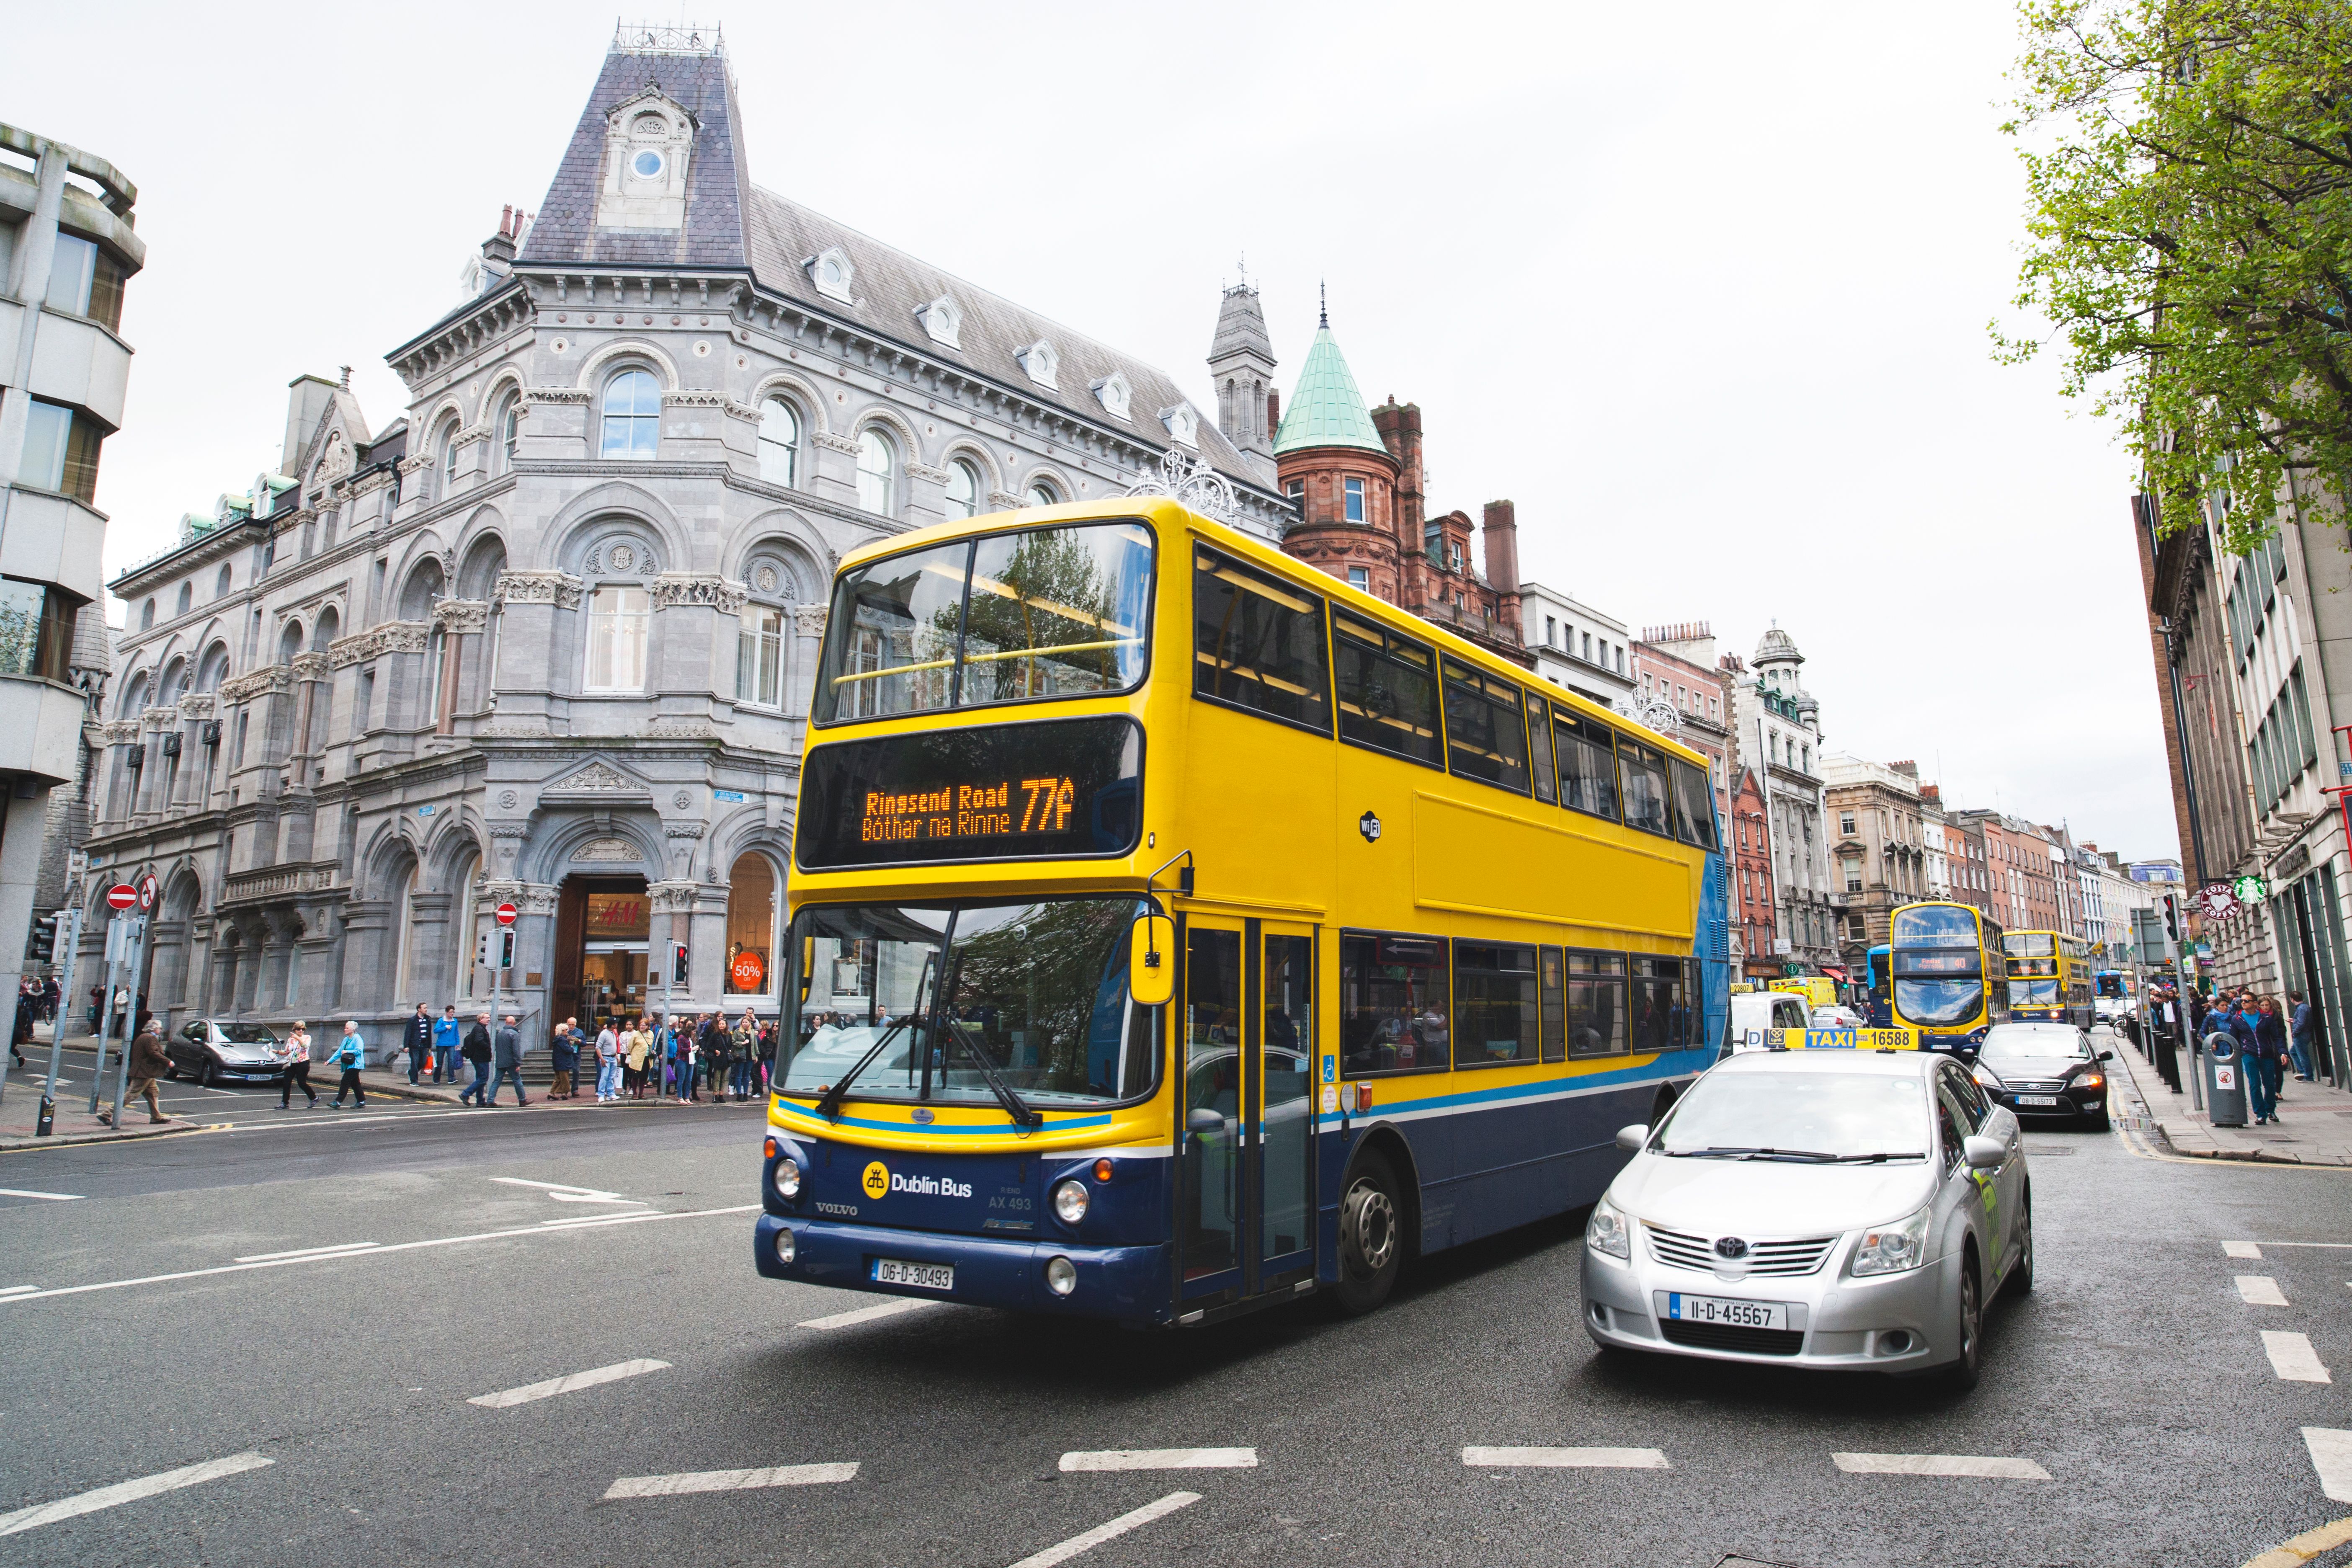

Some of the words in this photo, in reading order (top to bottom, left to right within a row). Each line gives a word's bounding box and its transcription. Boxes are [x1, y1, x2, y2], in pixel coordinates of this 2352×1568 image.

[866, 787, 951, 815] Ringsend
[959, 782, 1008, 809] Road
[1021, 777, 1074, 831] 77A
[862, 817, 922, 841] Bóthar
[929, 818, 951, 837] na
[958, 811, 1010, 835] Rinne
[2205, 886, 2232, 895] COSTA
[601, 901, 640, 927] H&M
[2205, 906, 2238, 918] COFFEE
[1955, 958, 1966, 968] 40
[735, 965, 760, 977] 50%
[1749, 1032, 1760, 1044] D
[1808, 1032, 1854, 1046] TAXI
[1871, 1031, 1909, 1046] 16588
[892, 1173, 939, 1194] Dublin
[941, 1178, 972, 1198] Bus
[815, 1202, 858, 1216] VOLVO
[988, 1197, 1006, 1208] AX
[1008, 1197, 1032, 1210] 493
[882, 1263, 949, 1287] 06-D-30493
[1692, 1301, 1772, 1326] 11-D-45567
